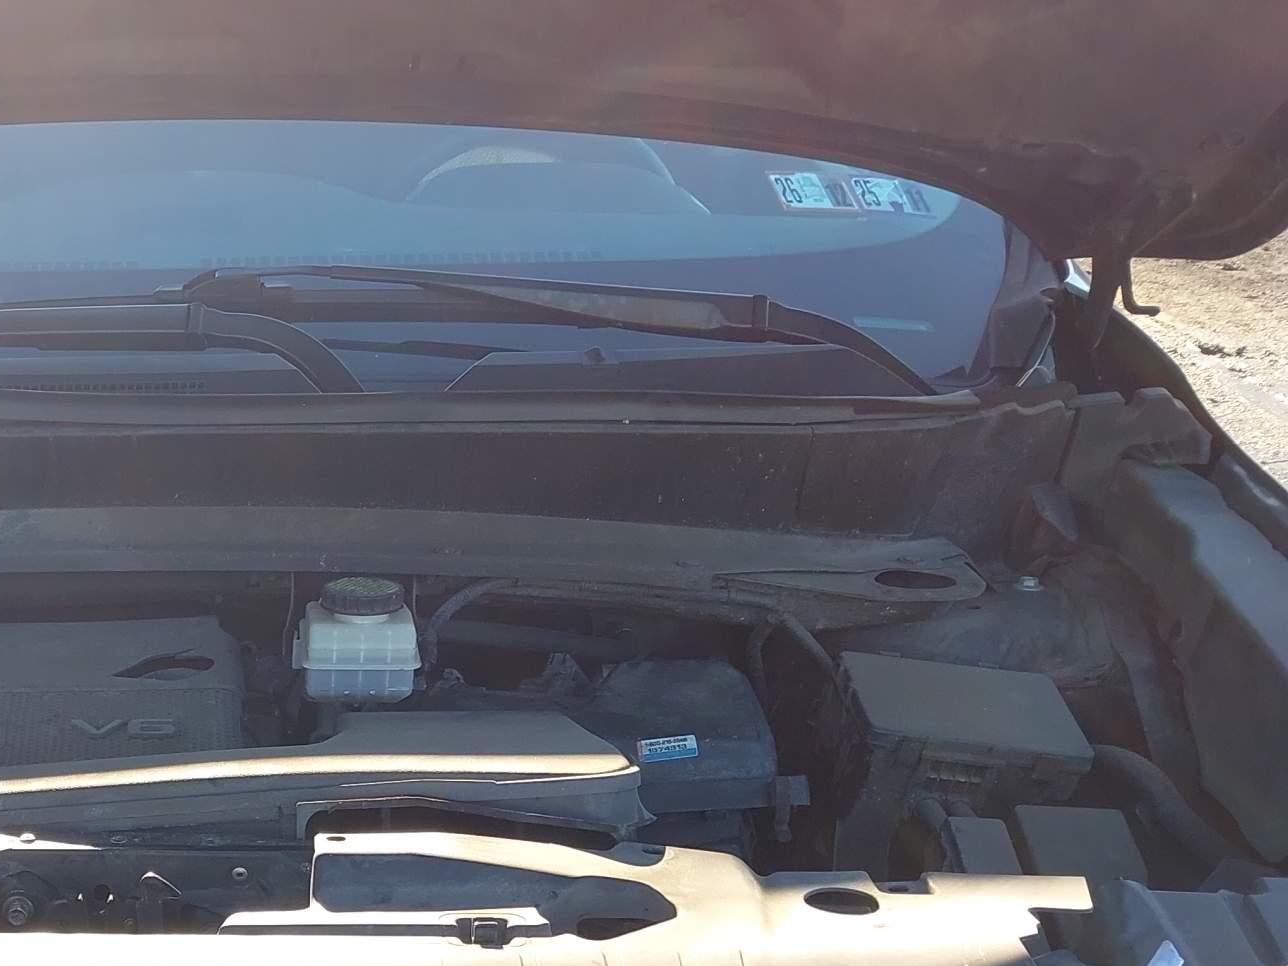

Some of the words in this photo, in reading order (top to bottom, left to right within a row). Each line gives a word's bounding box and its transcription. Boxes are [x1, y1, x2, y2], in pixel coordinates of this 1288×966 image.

[774, 177, 803, 204] 26
[854, 179, 882, 207] 25
[71, 718, 176, 738] V6
